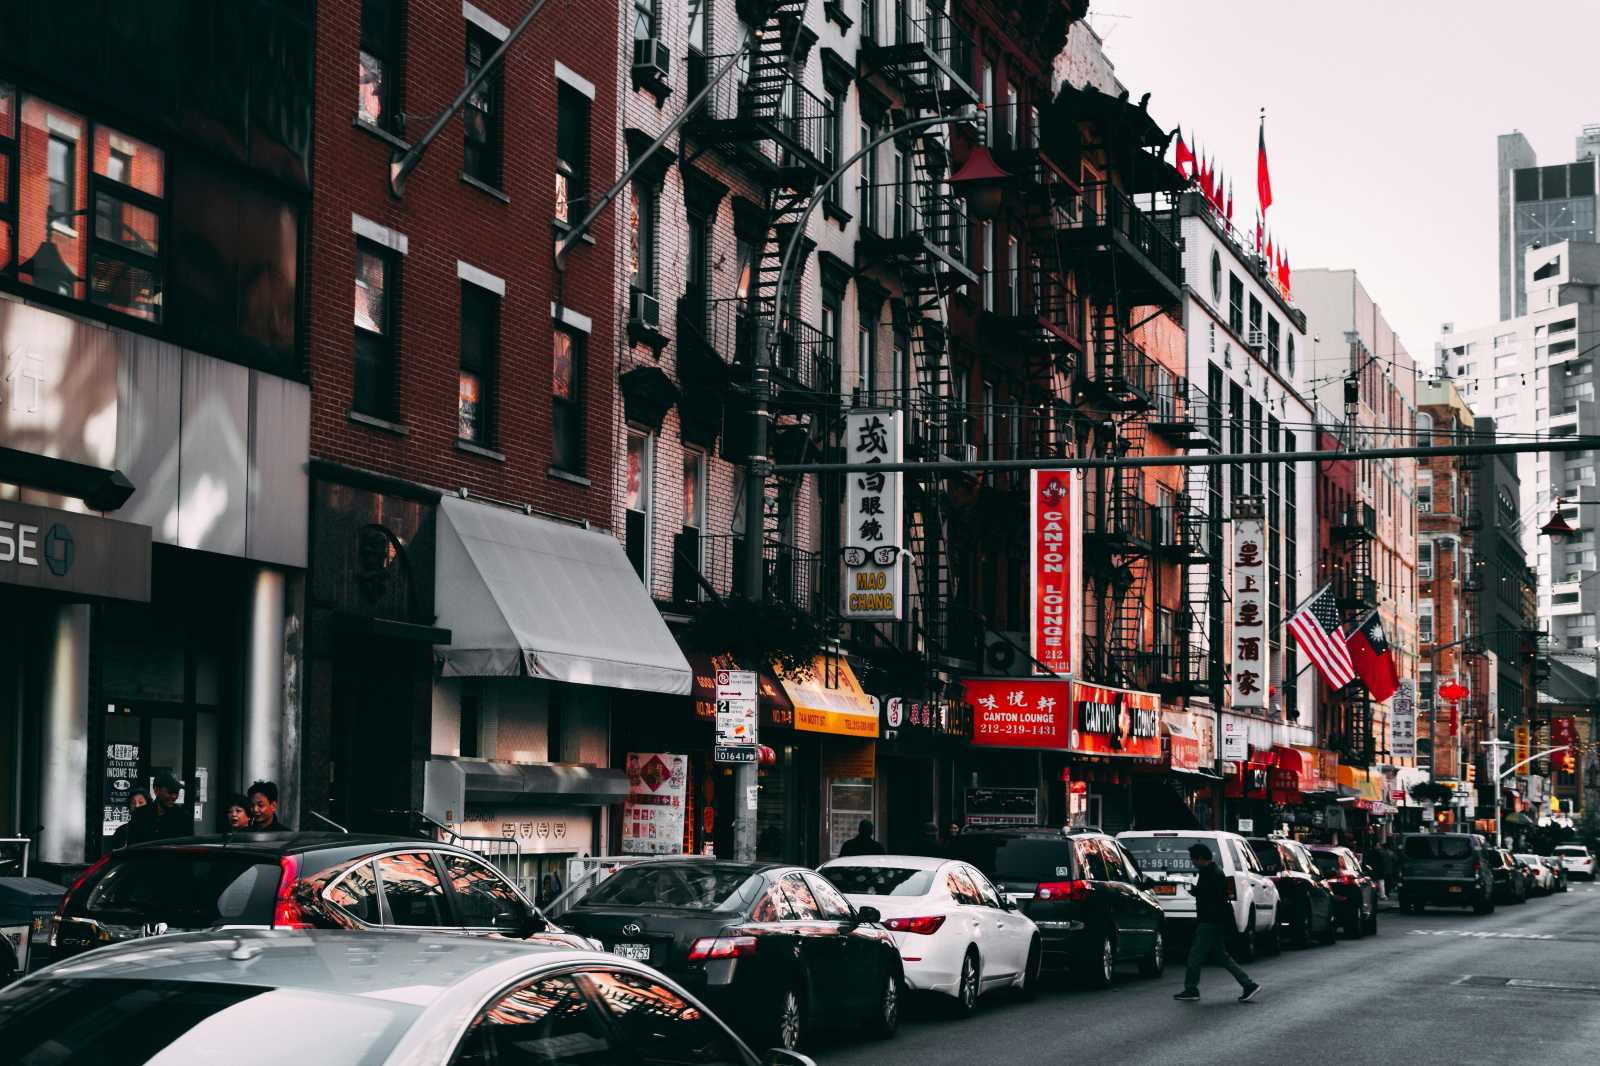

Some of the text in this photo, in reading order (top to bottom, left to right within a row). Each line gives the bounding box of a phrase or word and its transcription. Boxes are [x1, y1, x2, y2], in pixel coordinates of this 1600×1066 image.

[856, 571, 887, 591] MAO
[1043, 511, 1063, 646] CANTON LOUNGE
[848, 592, 894, 612] CHANG
[1235, 540, 1262, 696] 皇上皇酒家
[719, 700, 728, 713] 2
[983, 711, 1055, 724] CANTON LOUNGE
[1085, 701, 1116, 733] CANTON
[980, 723, 1056, 735] 212-219-1431
[107, 767, 138, 779] INCOME TAX
